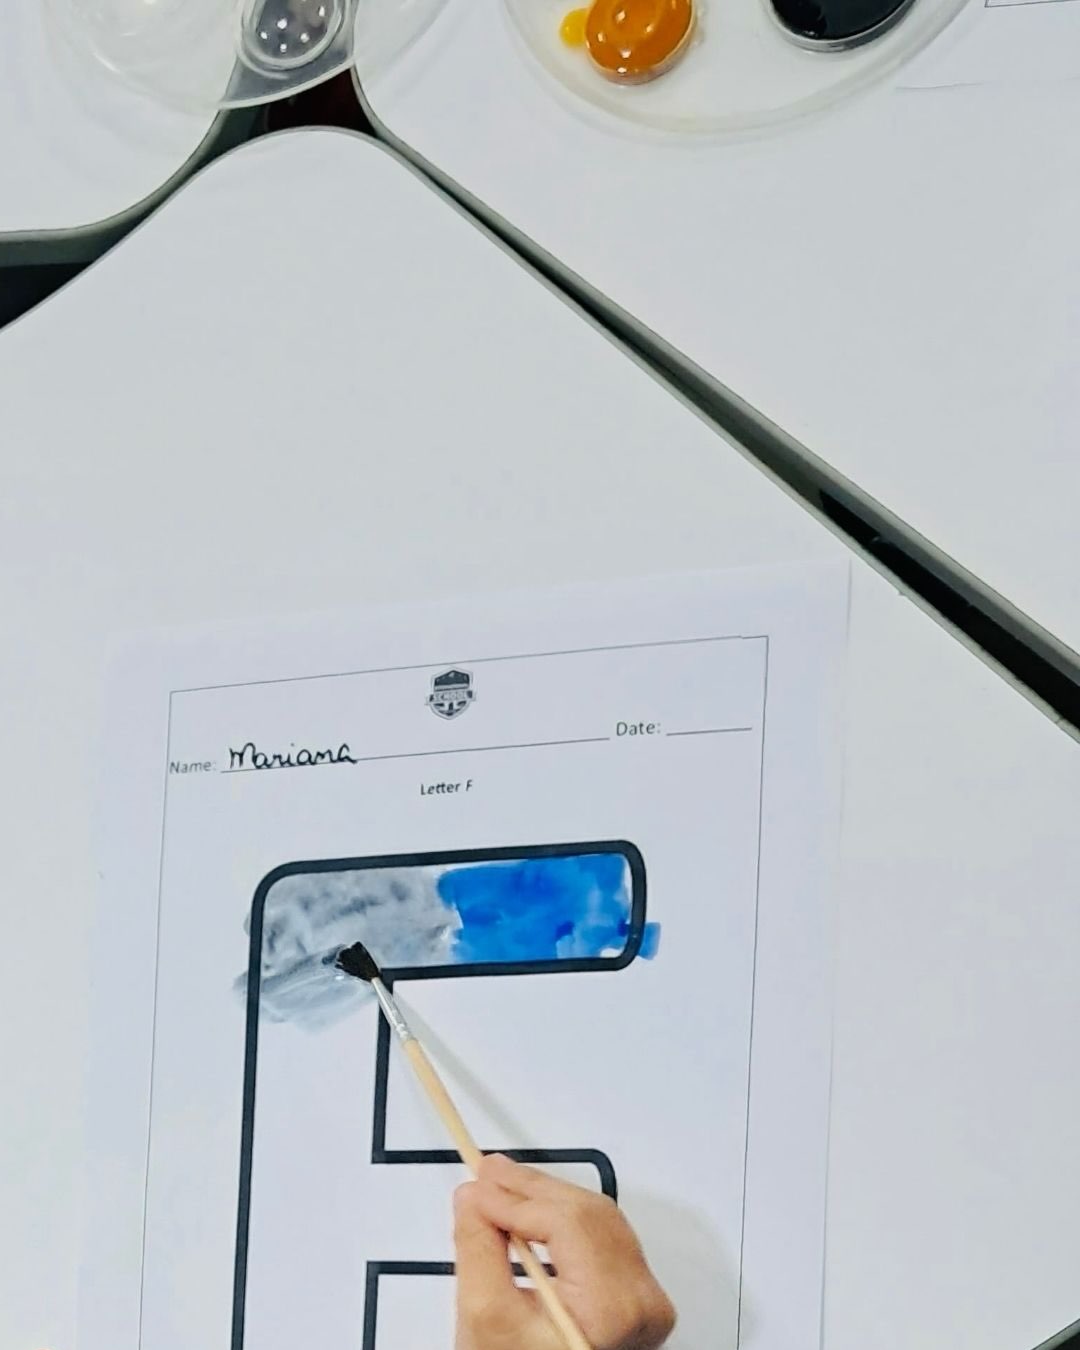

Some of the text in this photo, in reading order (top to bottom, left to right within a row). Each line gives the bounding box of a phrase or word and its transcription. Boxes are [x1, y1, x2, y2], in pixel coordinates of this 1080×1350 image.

[615, 721, 662, 737] Date:
[228, 742, 358, 770] Mariana
[169, 760, 217, 775] Name:
[420, 779, 473, 796] Letter F
